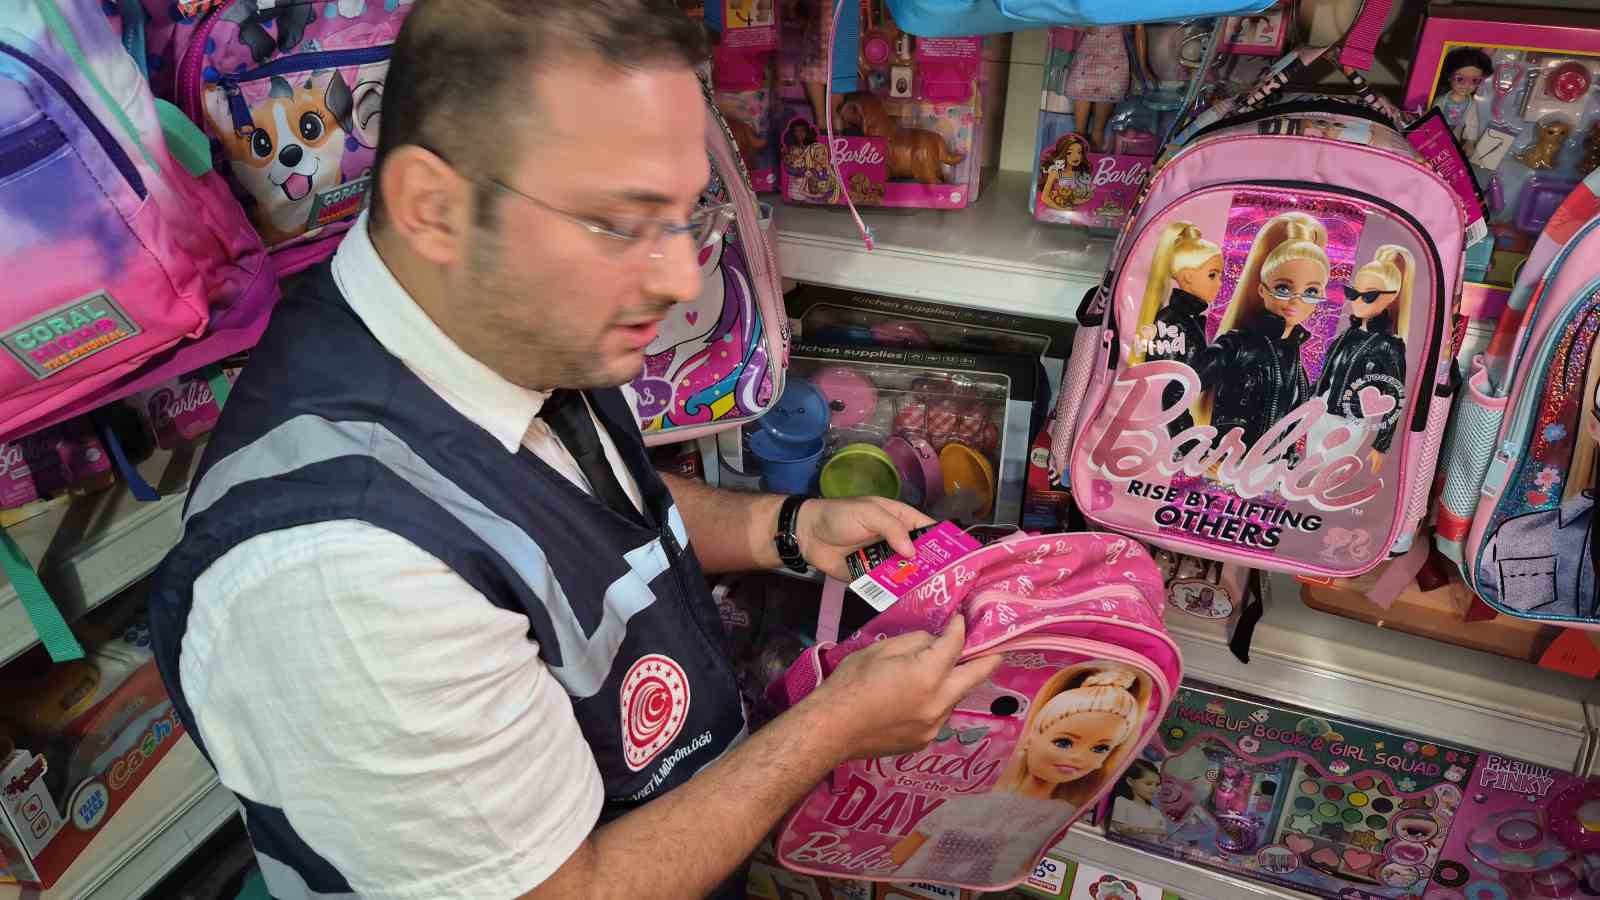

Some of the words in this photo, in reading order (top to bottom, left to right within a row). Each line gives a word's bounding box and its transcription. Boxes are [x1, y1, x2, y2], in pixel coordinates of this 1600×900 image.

[832, 138, 884, 165] Barbie
[15, 304, 107, 349] CORAL
[844, 349, 903, 362] supplies
[147, 380, 214, 426] Barbie
[1086, 358, 1386, 511] Barbie
[1127, 479, 1181, 503] RISE
[1184, 491, 1219, 511] BY
[1223, 498, 1323, 532] LIFTING
[1151, 505, 1283, 550] OTHERS
[1177, 708, 1250, 732] MAKEUP
[1252, 724, 1307, 748] BOOK
[1311, 738, 1323, 751] &
[1330, 742, 1368, 763] GIRL
[1375, 752, 1441, 778] SQUAD
[896, 775, 921, 787] for
[923, 780, 950, 792] the
[1480, 767, 1555, 796] PINKY
[823, 772, 948, 838] DAY
[786, 830, 902, 872] Barbie
